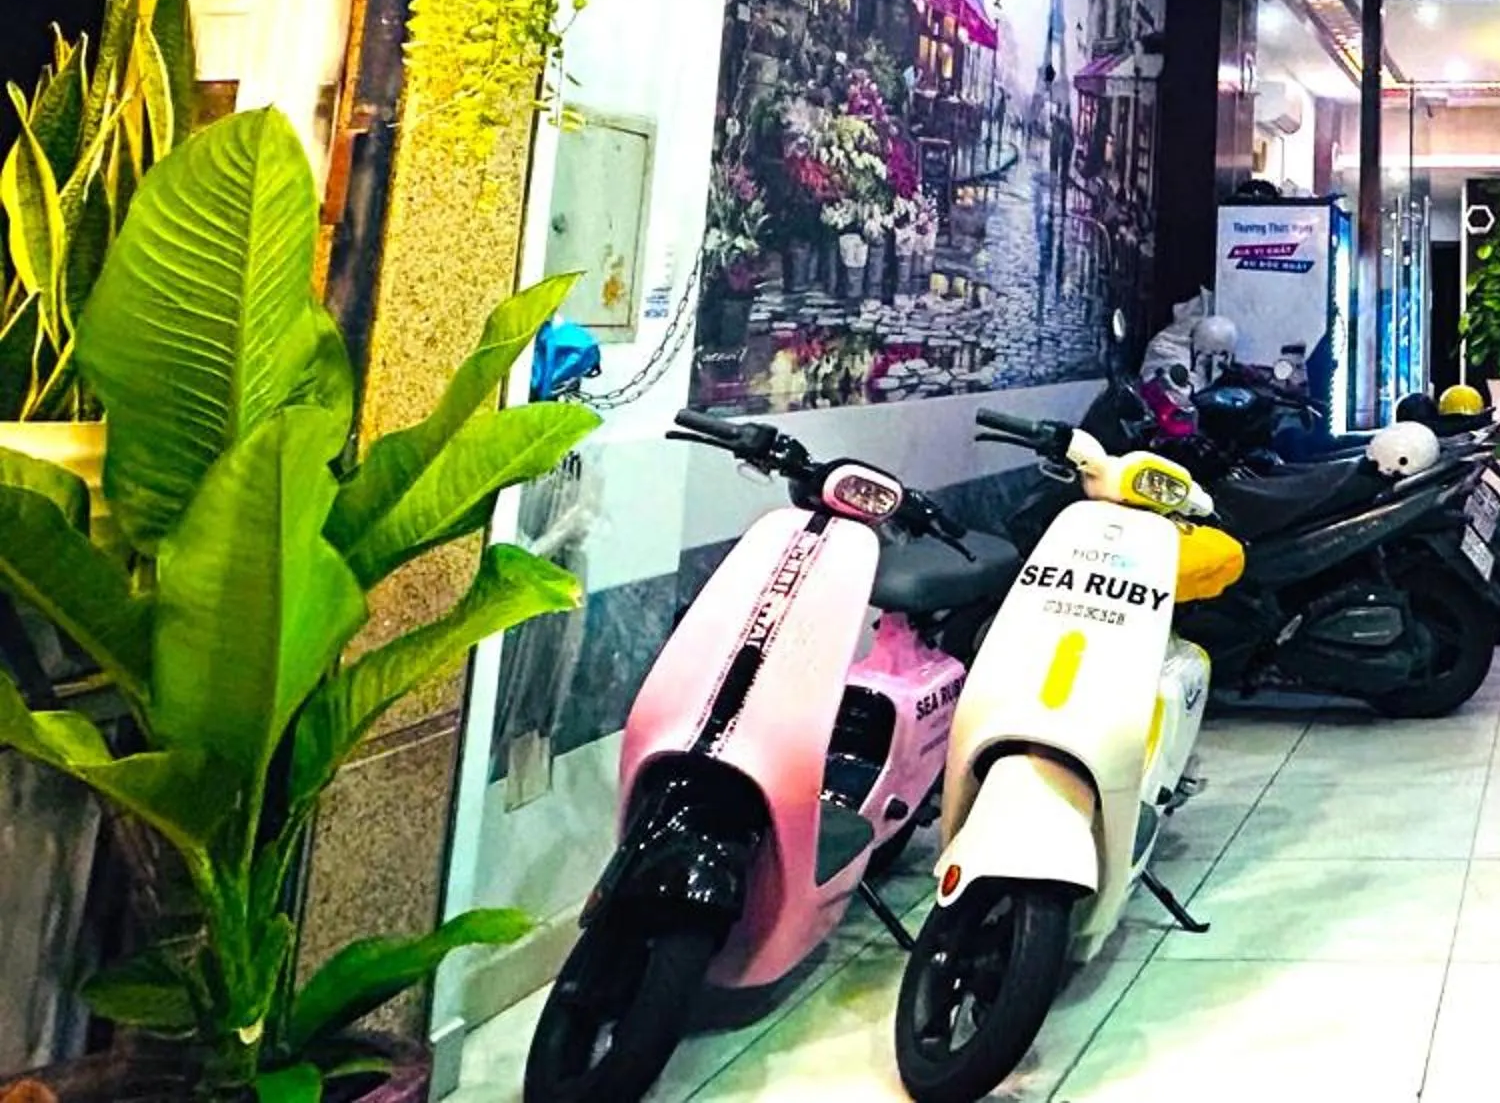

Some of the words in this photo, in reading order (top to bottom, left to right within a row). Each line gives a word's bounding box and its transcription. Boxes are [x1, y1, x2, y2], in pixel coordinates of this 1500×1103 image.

[1020, 564, 1074, 590] SEA
[1084, 572, 1170, 611] RUBY
[916, 692, 939, 721] SEA
